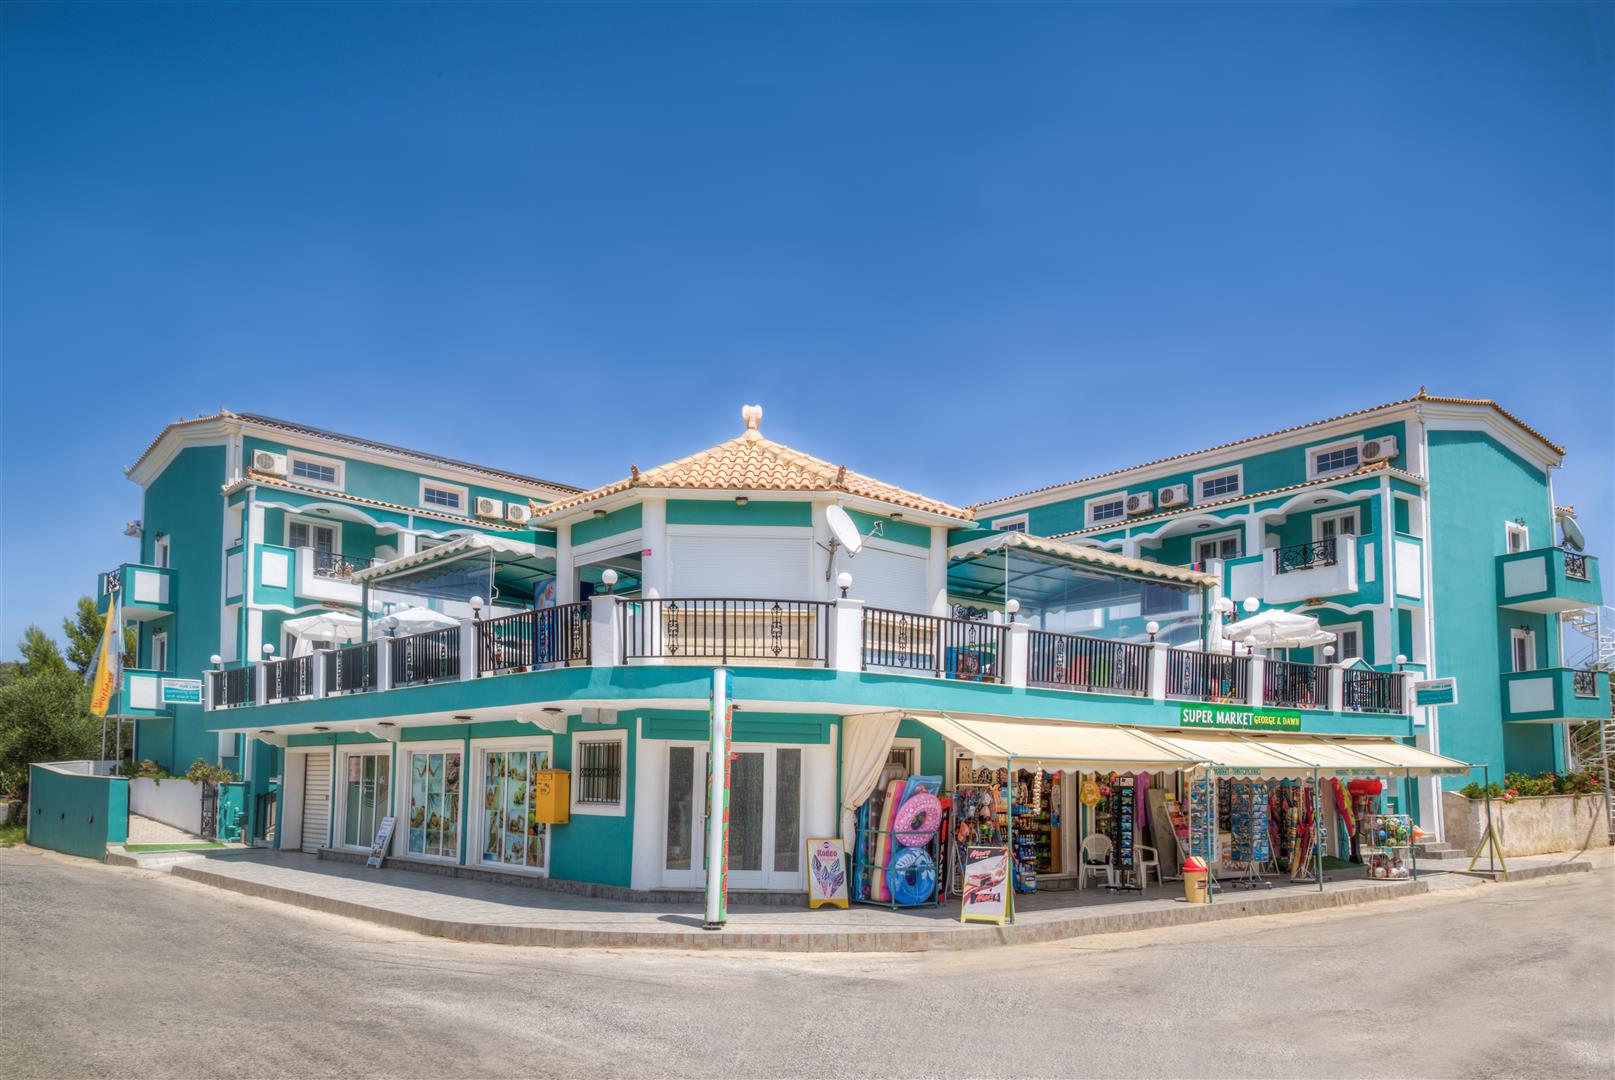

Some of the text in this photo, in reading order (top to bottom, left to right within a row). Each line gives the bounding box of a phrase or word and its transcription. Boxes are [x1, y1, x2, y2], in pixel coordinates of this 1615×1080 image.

[1183, 709, 1213, 724] SUPER
[1216, 711, 1254, 726] MARKET
[1254, 715, 1276, 726] GEORGE
[1282, 717, 1300, 726] DAWN
